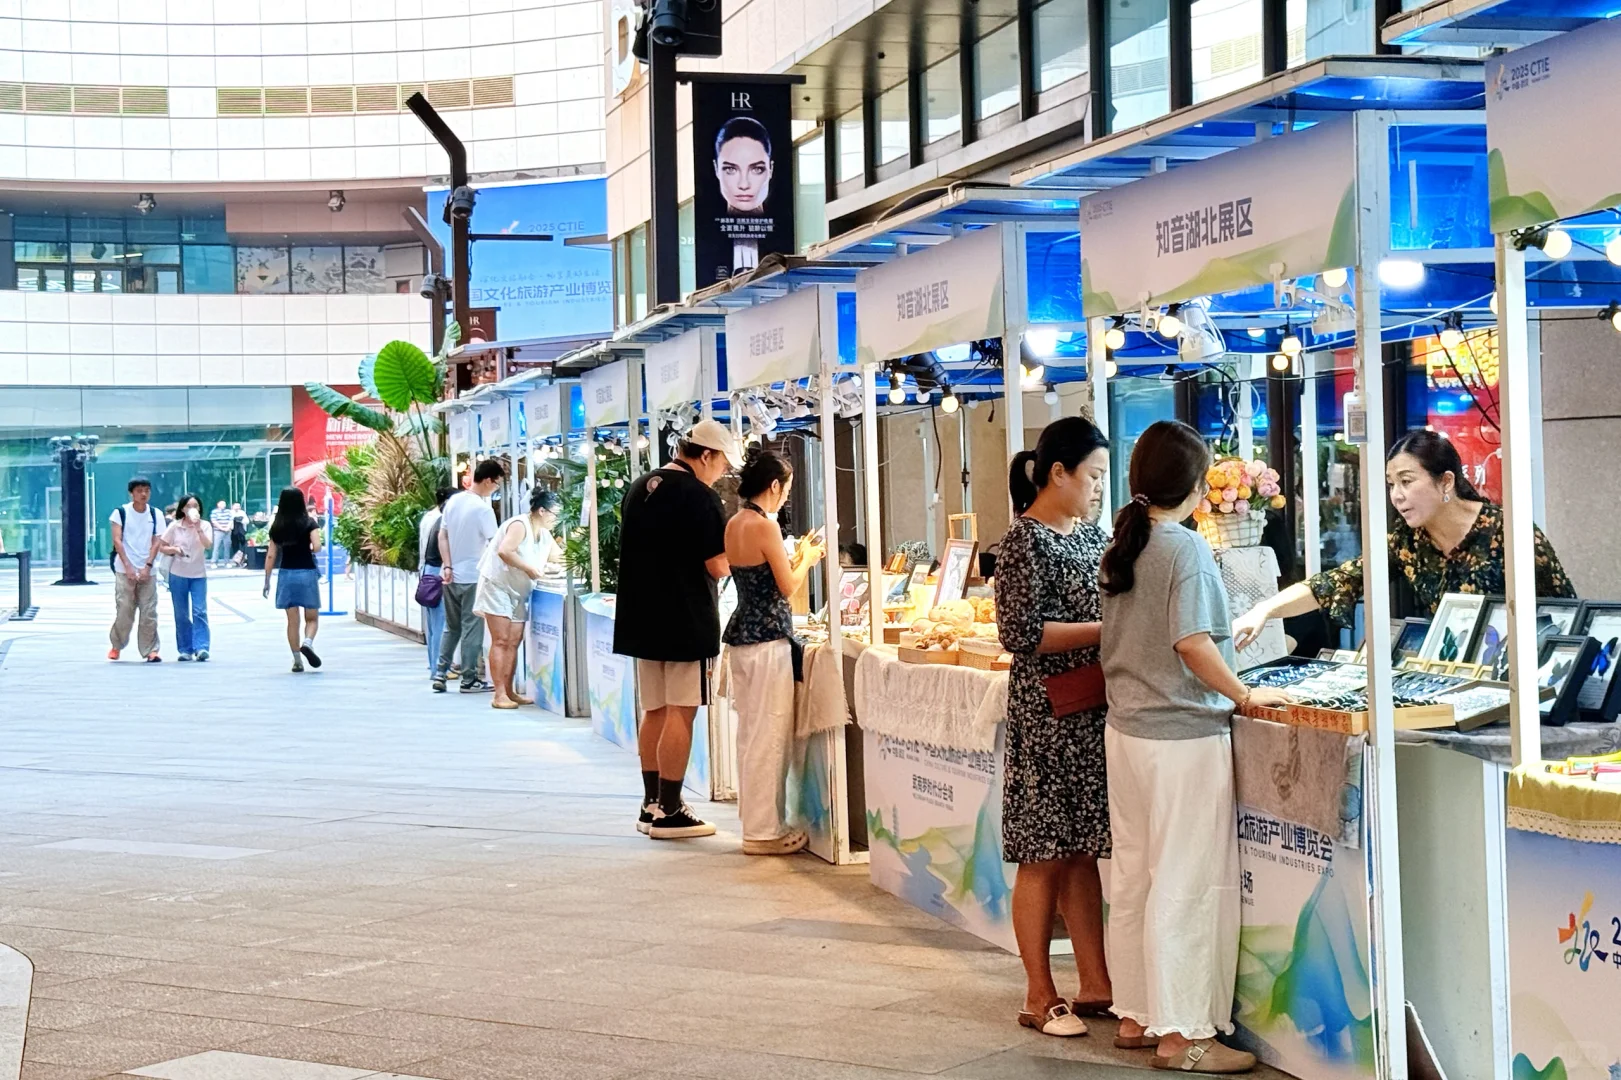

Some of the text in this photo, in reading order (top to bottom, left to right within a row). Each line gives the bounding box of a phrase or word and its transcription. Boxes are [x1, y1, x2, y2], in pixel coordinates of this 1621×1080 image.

[1511, 63, 1529, 81] 2025
[1531, 57, 1550, 76] CTIE
[731, 92, 753, 108] HR
[529, 221, 585, 233] 2025 CTIE
[1156, 197, 1253, 258] 知音湖北展区
[897, 279, 949, 321] 知音湖北展区
[1250, 846, 1277, 862] TOURISM
[1279, 855, 1315, 873] INDUSTRIES
[1318, 865, 1335, 878] EXPO
